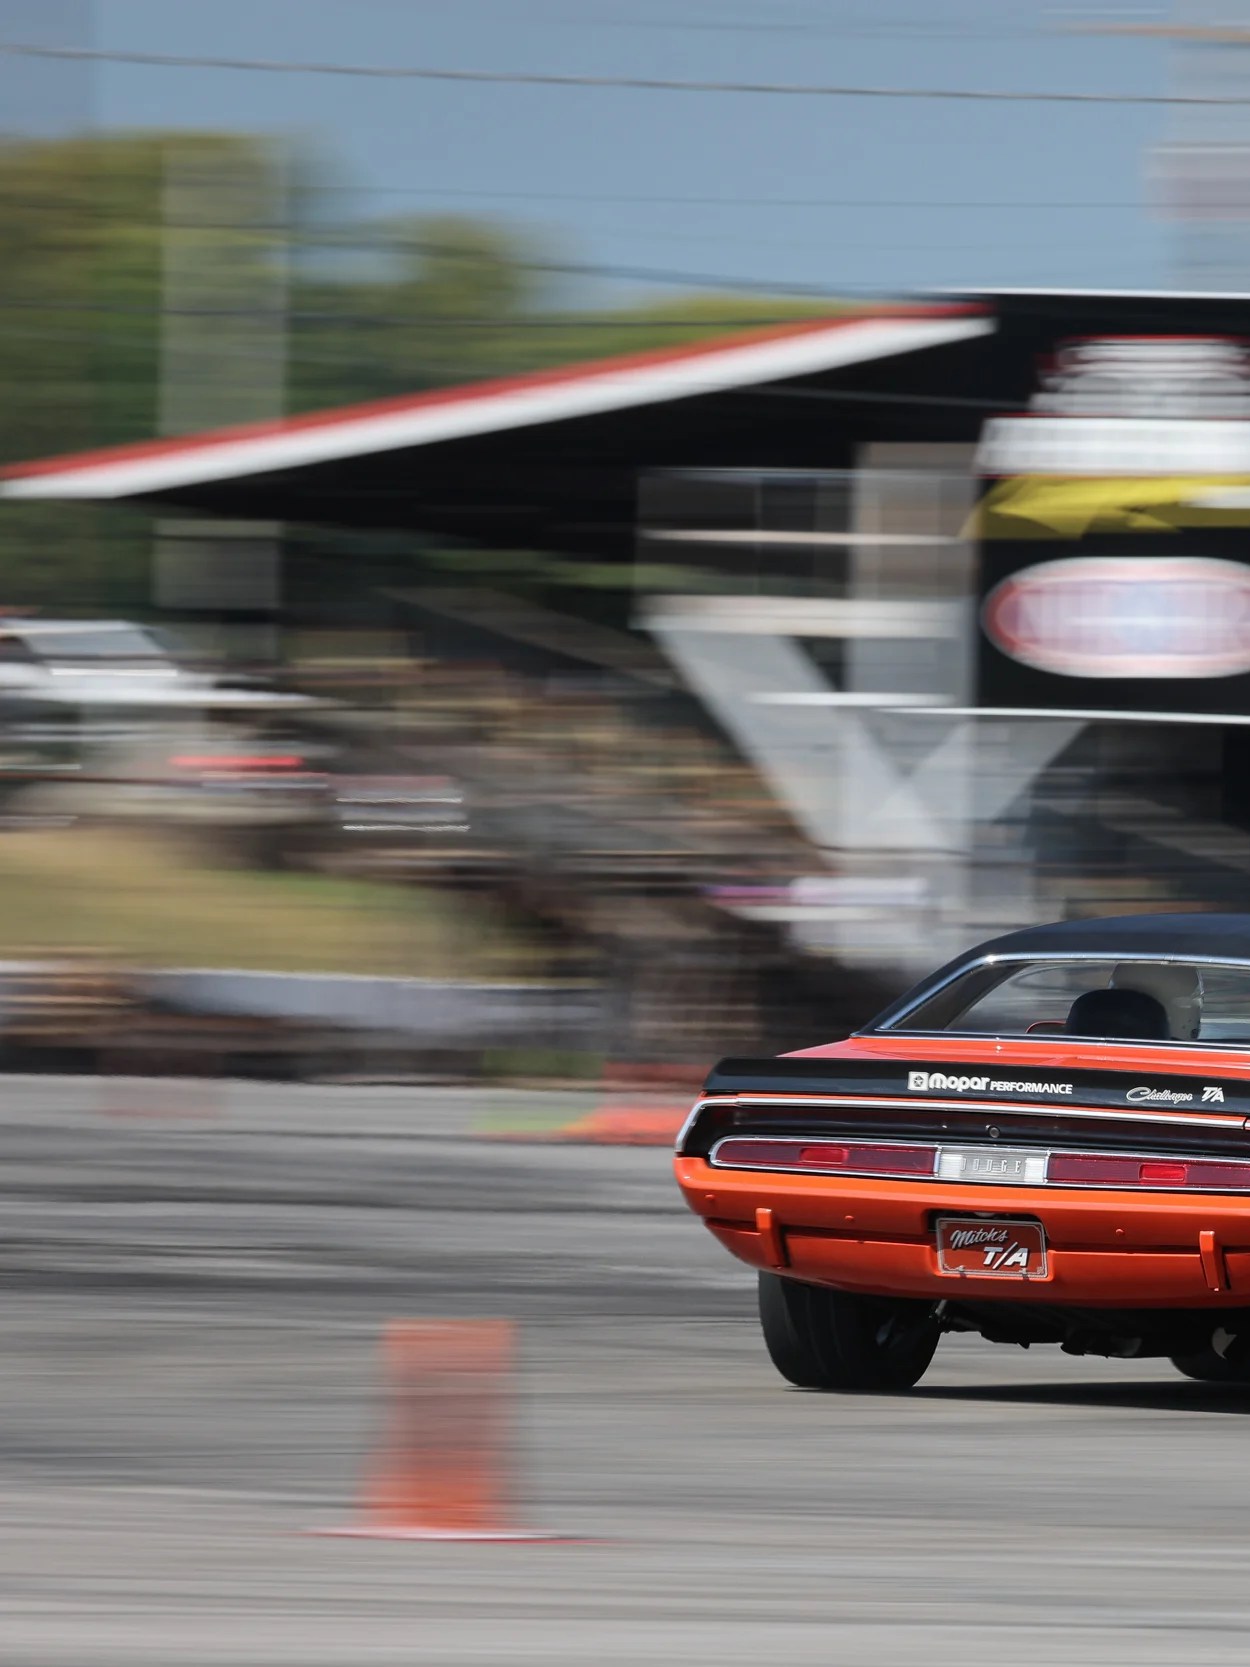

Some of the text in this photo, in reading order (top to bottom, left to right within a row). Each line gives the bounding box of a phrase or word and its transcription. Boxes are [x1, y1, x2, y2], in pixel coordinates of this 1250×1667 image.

[928, 1072, 1073, 1095] Mopar PERFORMANCE
[1126, 1086, 1225, 1104] Challenger T/A
[950, 1227, 1009, 1250] Mitch's
[983, 1241, 1029, 1270] T/A
